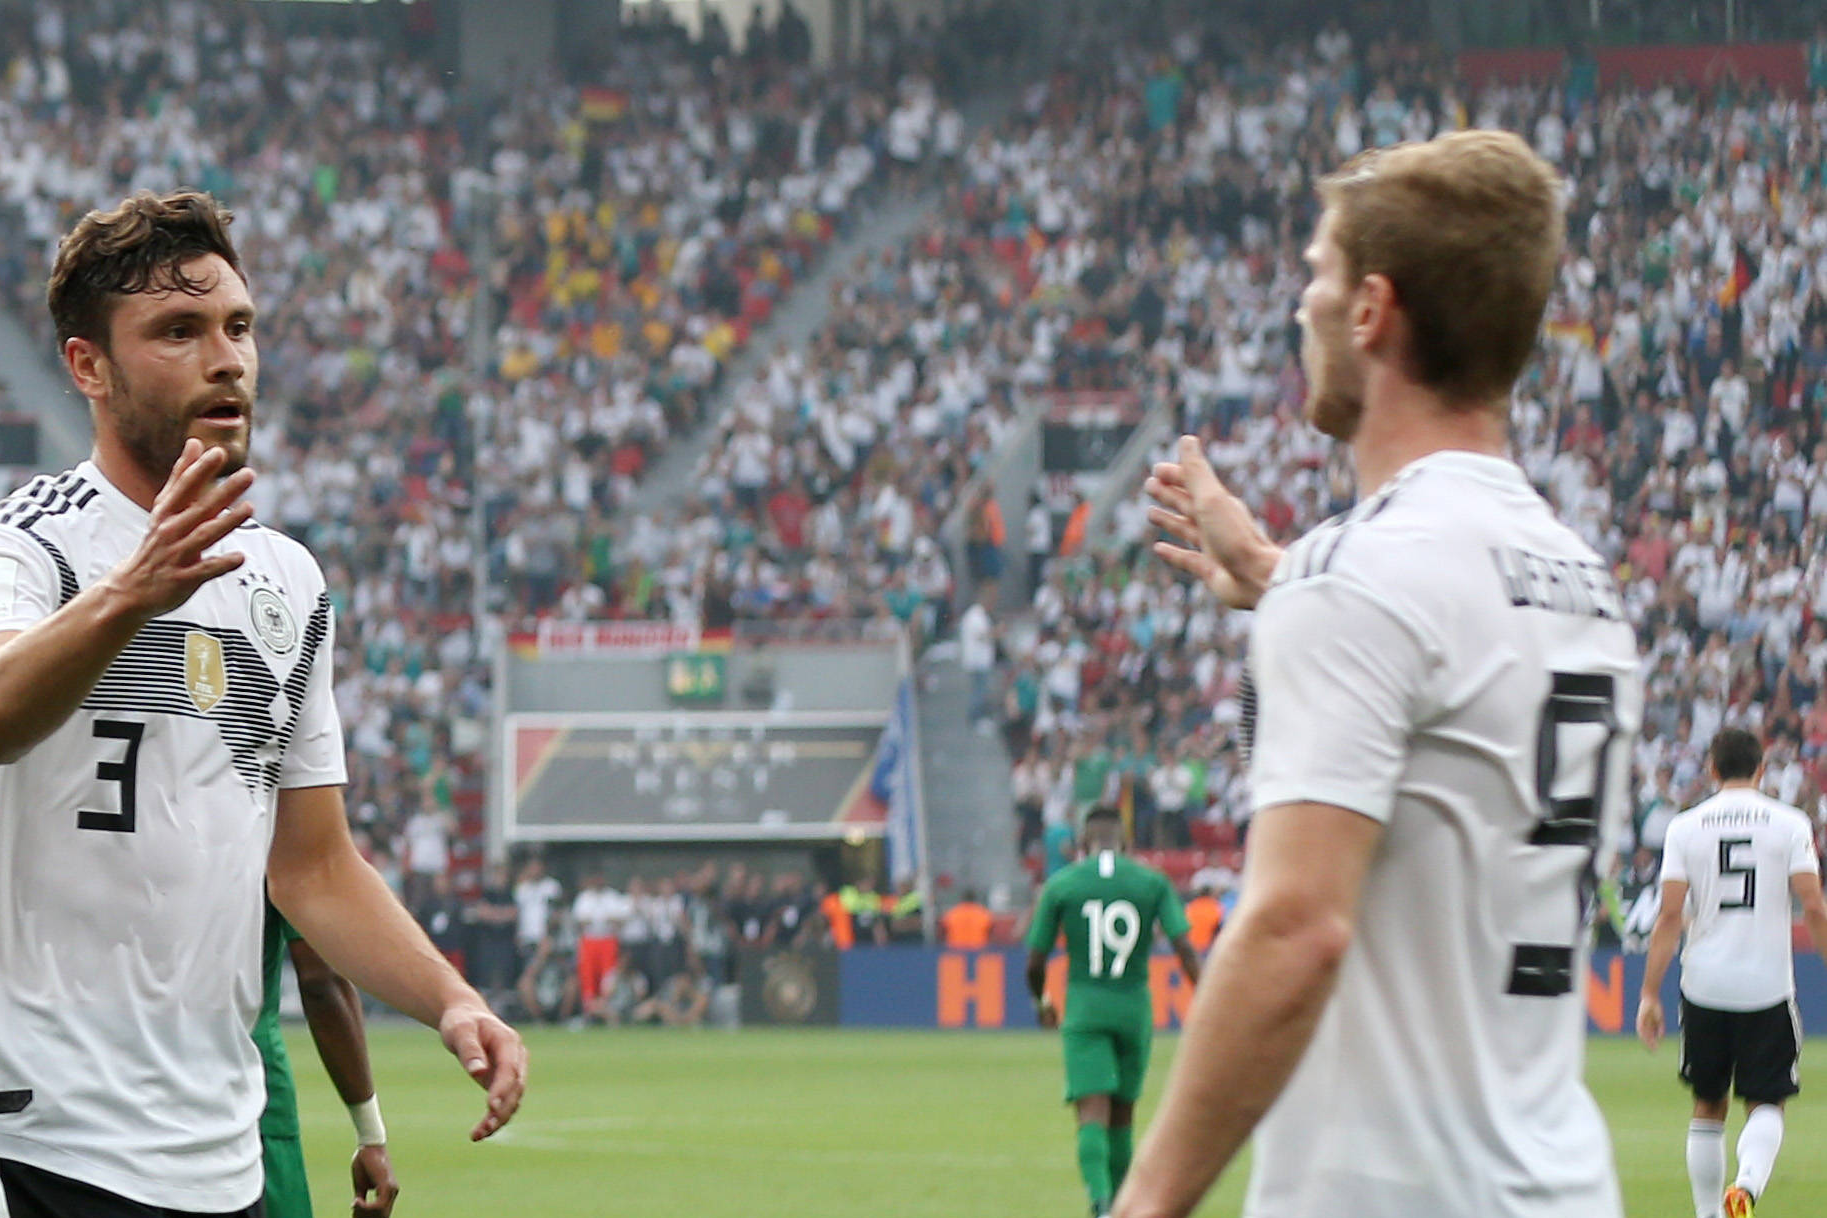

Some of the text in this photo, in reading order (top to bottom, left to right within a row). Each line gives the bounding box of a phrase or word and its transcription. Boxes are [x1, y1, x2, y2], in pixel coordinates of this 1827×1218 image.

[77, 719, 145, 833] 3
[1719, 839, 1756, 910] 5
[1082, 899, 1142, 978] 19
